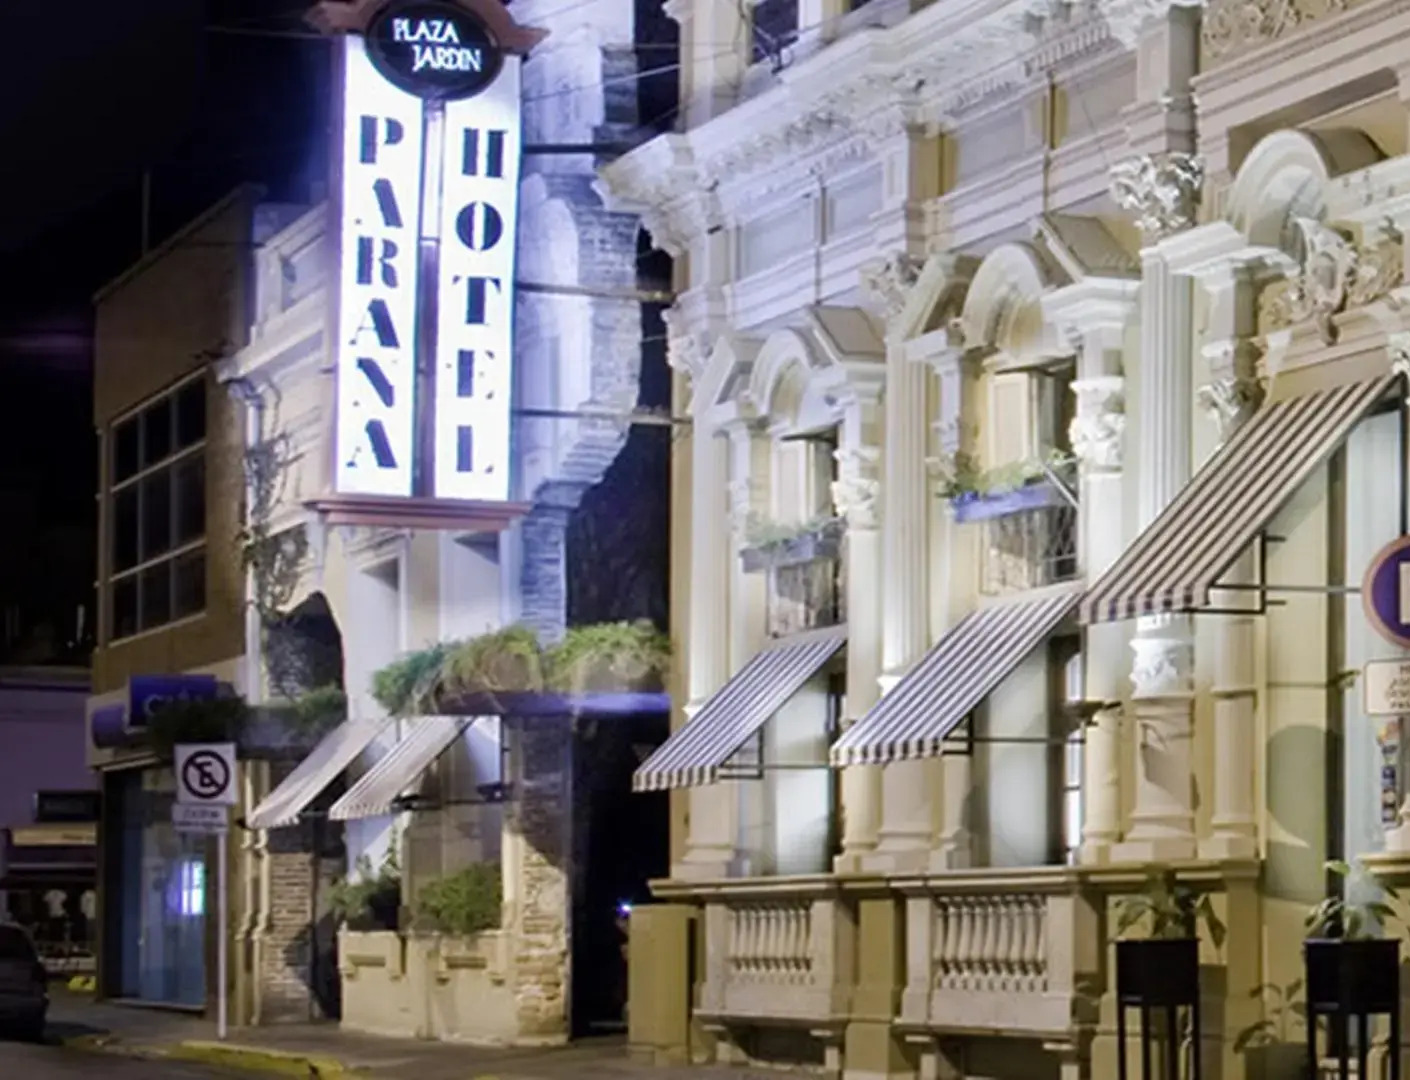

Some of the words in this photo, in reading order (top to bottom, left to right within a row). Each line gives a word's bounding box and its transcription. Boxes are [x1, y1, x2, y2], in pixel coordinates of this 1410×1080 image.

[393, 18, 459, 43] PLAZA
[412, 45, 481, 72] JARDIN
[346, 114, 403, 469] PARANA
[446, 128, 508, 473] HOTEL
